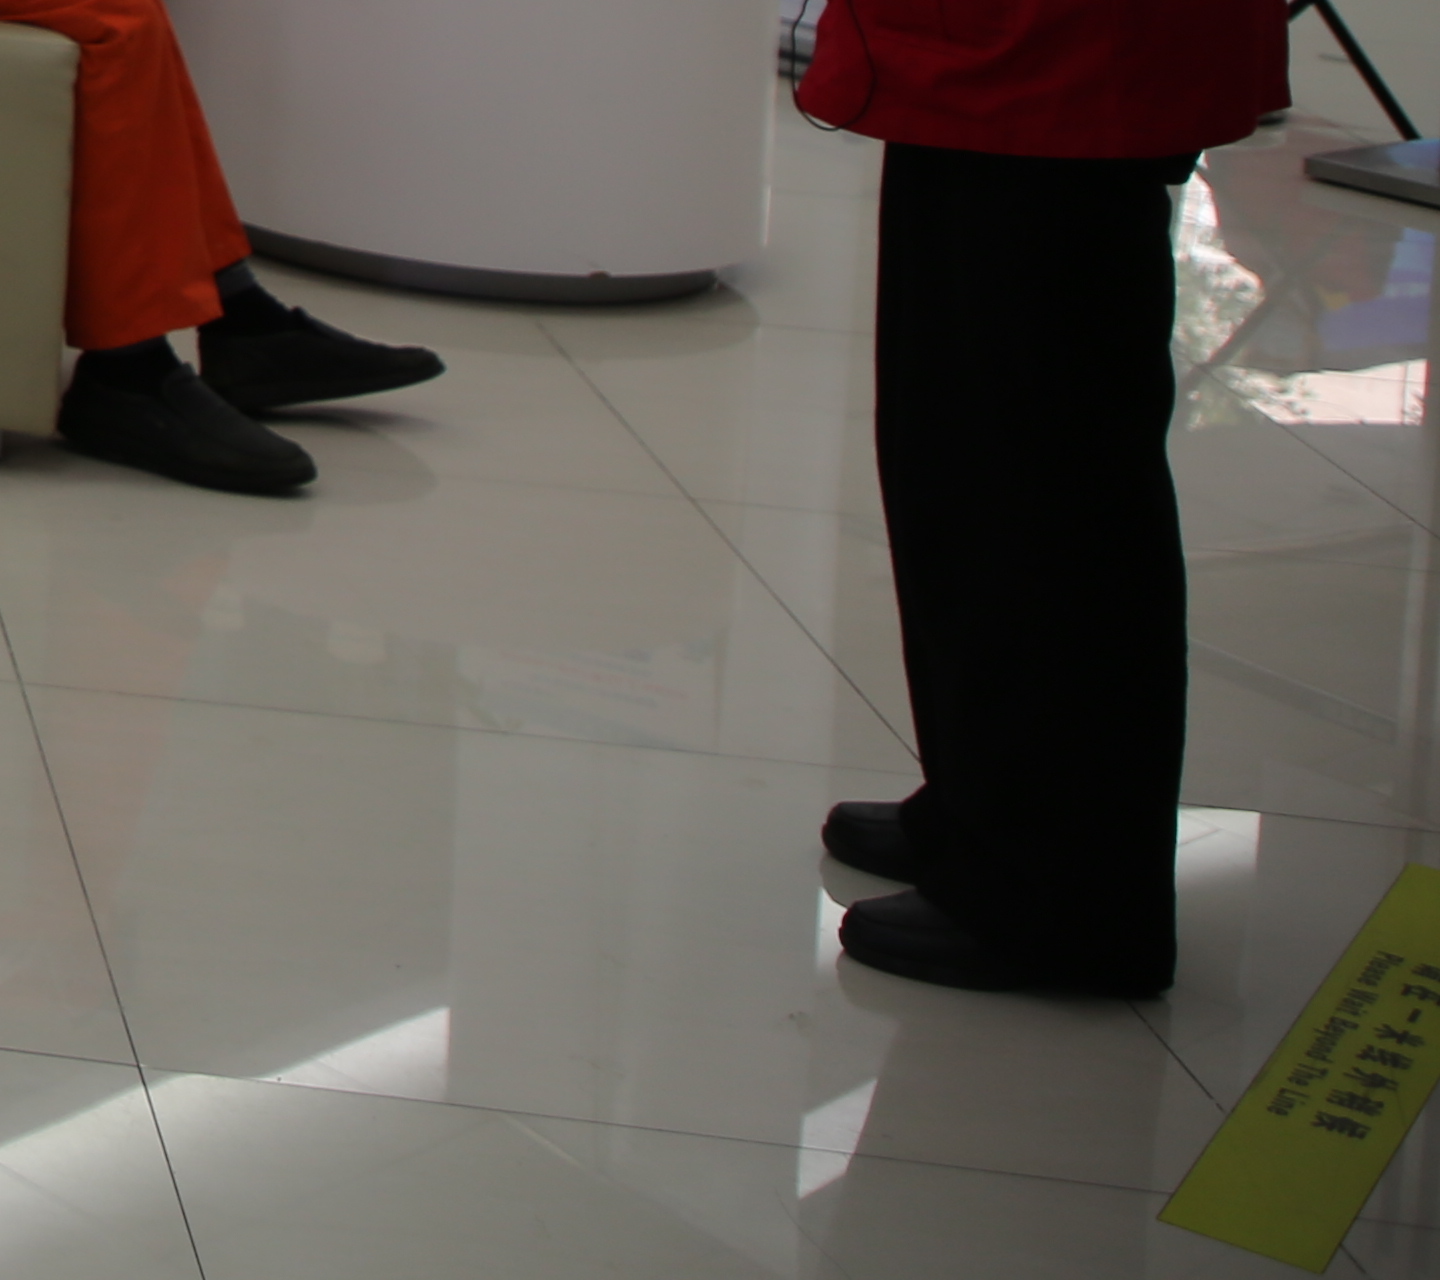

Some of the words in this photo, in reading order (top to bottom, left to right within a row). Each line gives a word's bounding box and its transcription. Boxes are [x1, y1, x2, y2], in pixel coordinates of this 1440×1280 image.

[1357, 950, 1405, 987] Please
[1335, 988, 1380, 1017] Wait
[1305, 1015, 1361, 1064] Beyond
[1287, 1062, 1329, 1087] The
[1266, 1086, 1312, 1117] Line
